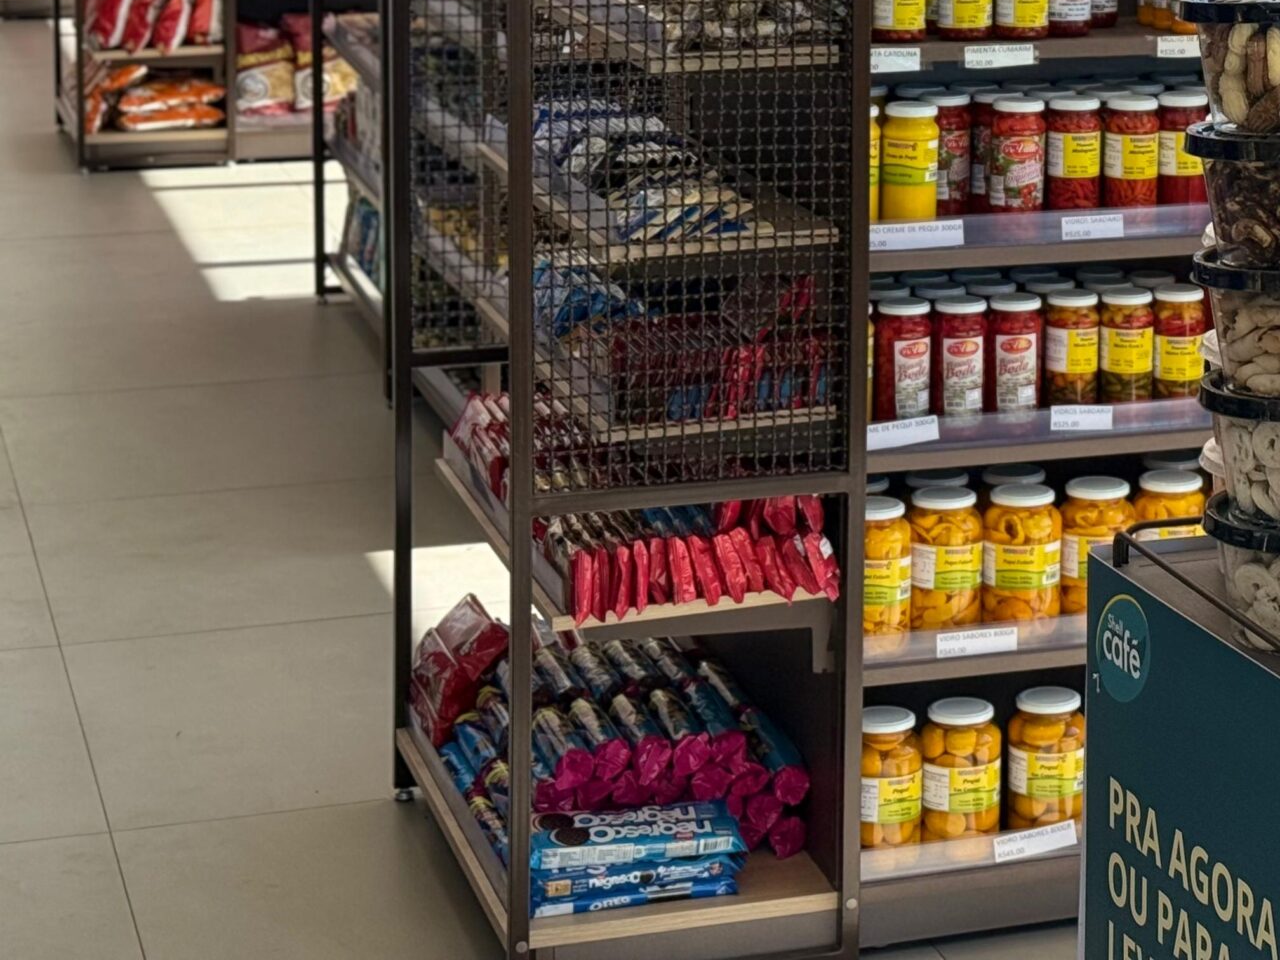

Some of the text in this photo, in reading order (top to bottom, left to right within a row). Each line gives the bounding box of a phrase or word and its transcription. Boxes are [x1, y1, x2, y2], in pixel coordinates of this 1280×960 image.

[892, 422, 913, 430] PEQUI
[1108, 613, 1123, 636] Shell
[1102, 629, 1140, 680] café
[1109, 776, 1162, 869] PRA
[1168, 828, 1278, 960] AGORA
[1108, 852, 1148, 926] OU
[1157, 889, 1232, 960] PARA
